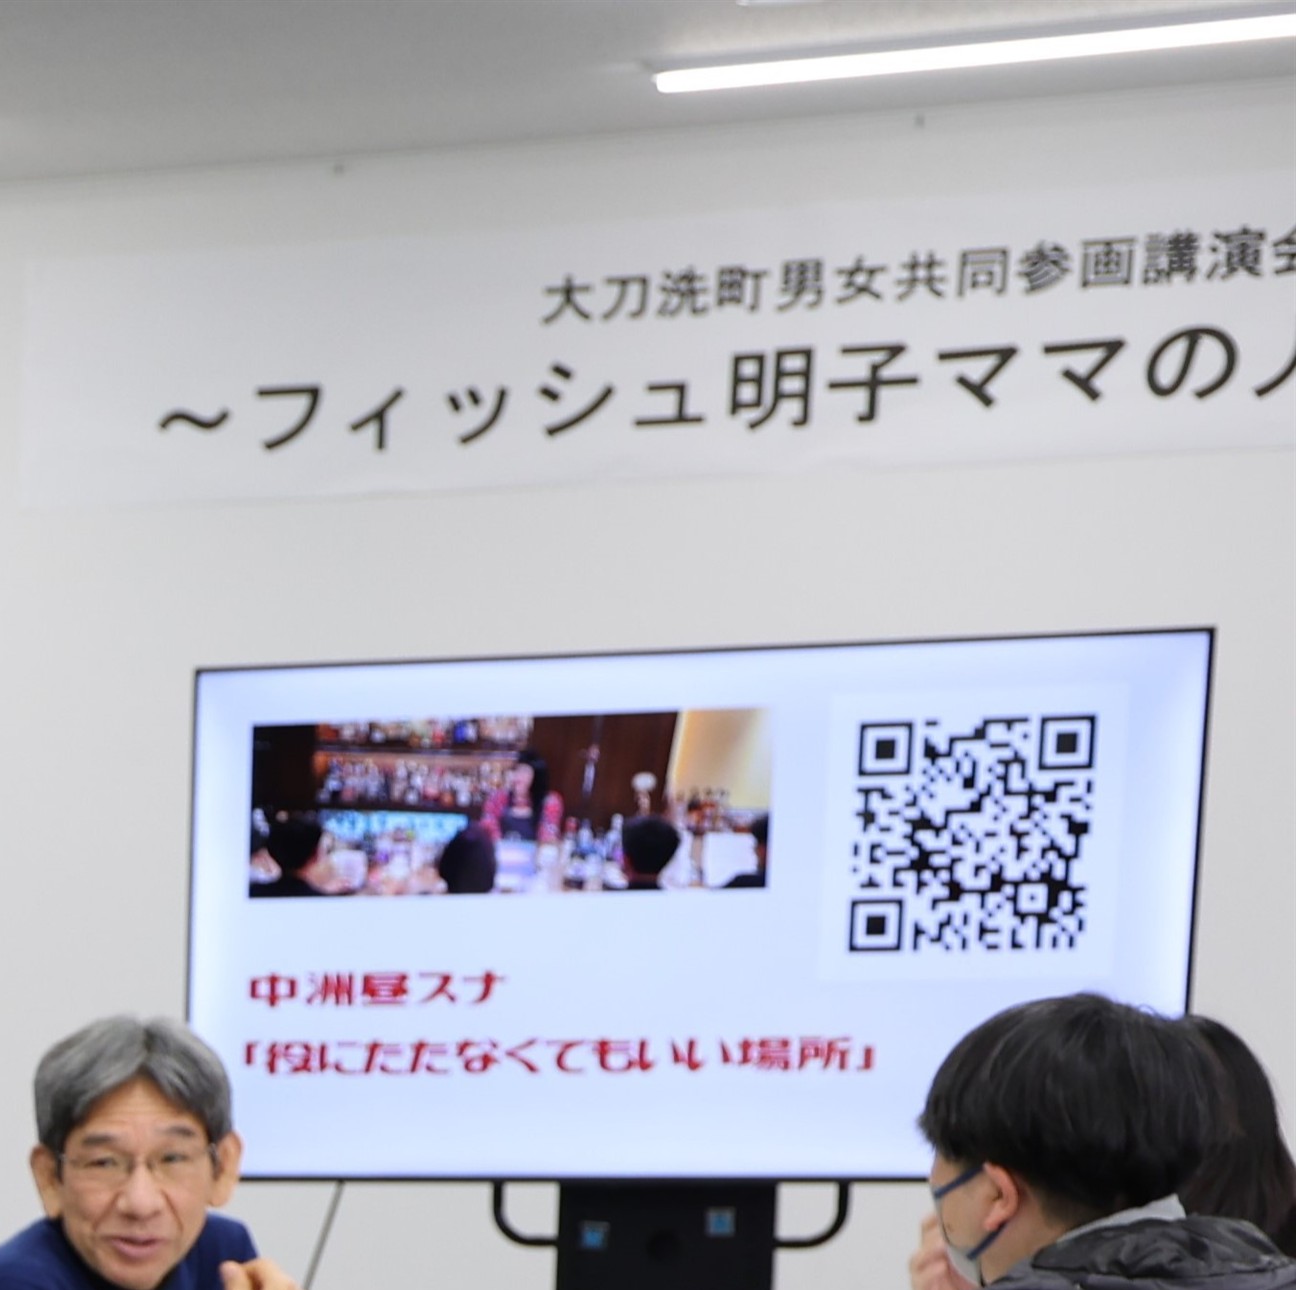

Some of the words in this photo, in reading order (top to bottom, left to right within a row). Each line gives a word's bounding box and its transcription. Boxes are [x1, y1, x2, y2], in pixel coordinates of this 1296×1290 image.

[247, 968, 509, 1009] 中洲昼スナ
[241, 1034, 878, 1078] 「役にたたなくてもいい場所」
